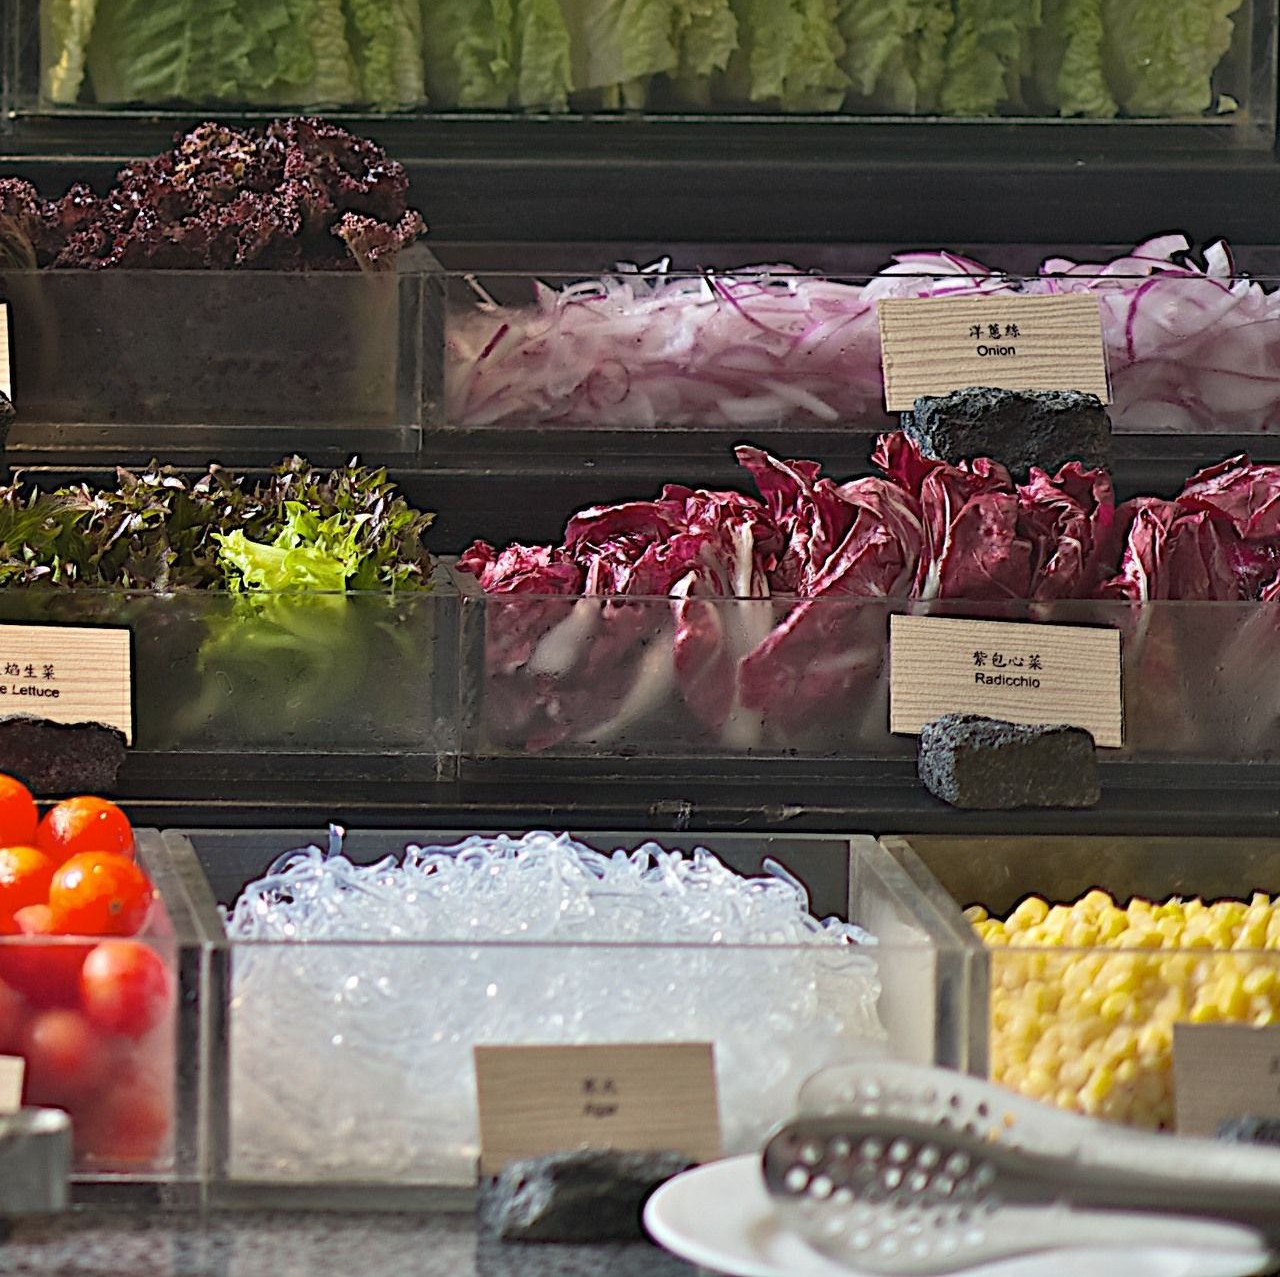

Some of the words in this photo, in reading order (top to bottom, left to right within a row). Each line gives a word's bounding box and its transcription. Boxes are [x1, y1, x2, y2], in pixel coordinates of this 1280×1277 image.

[977, 345, 1016, 356] Onion
[973, 651, 1043, 670] 紫包心菜
[975, 672, 1040, 688] Radicchio
[12, 684, 60, 697] Lettuce
